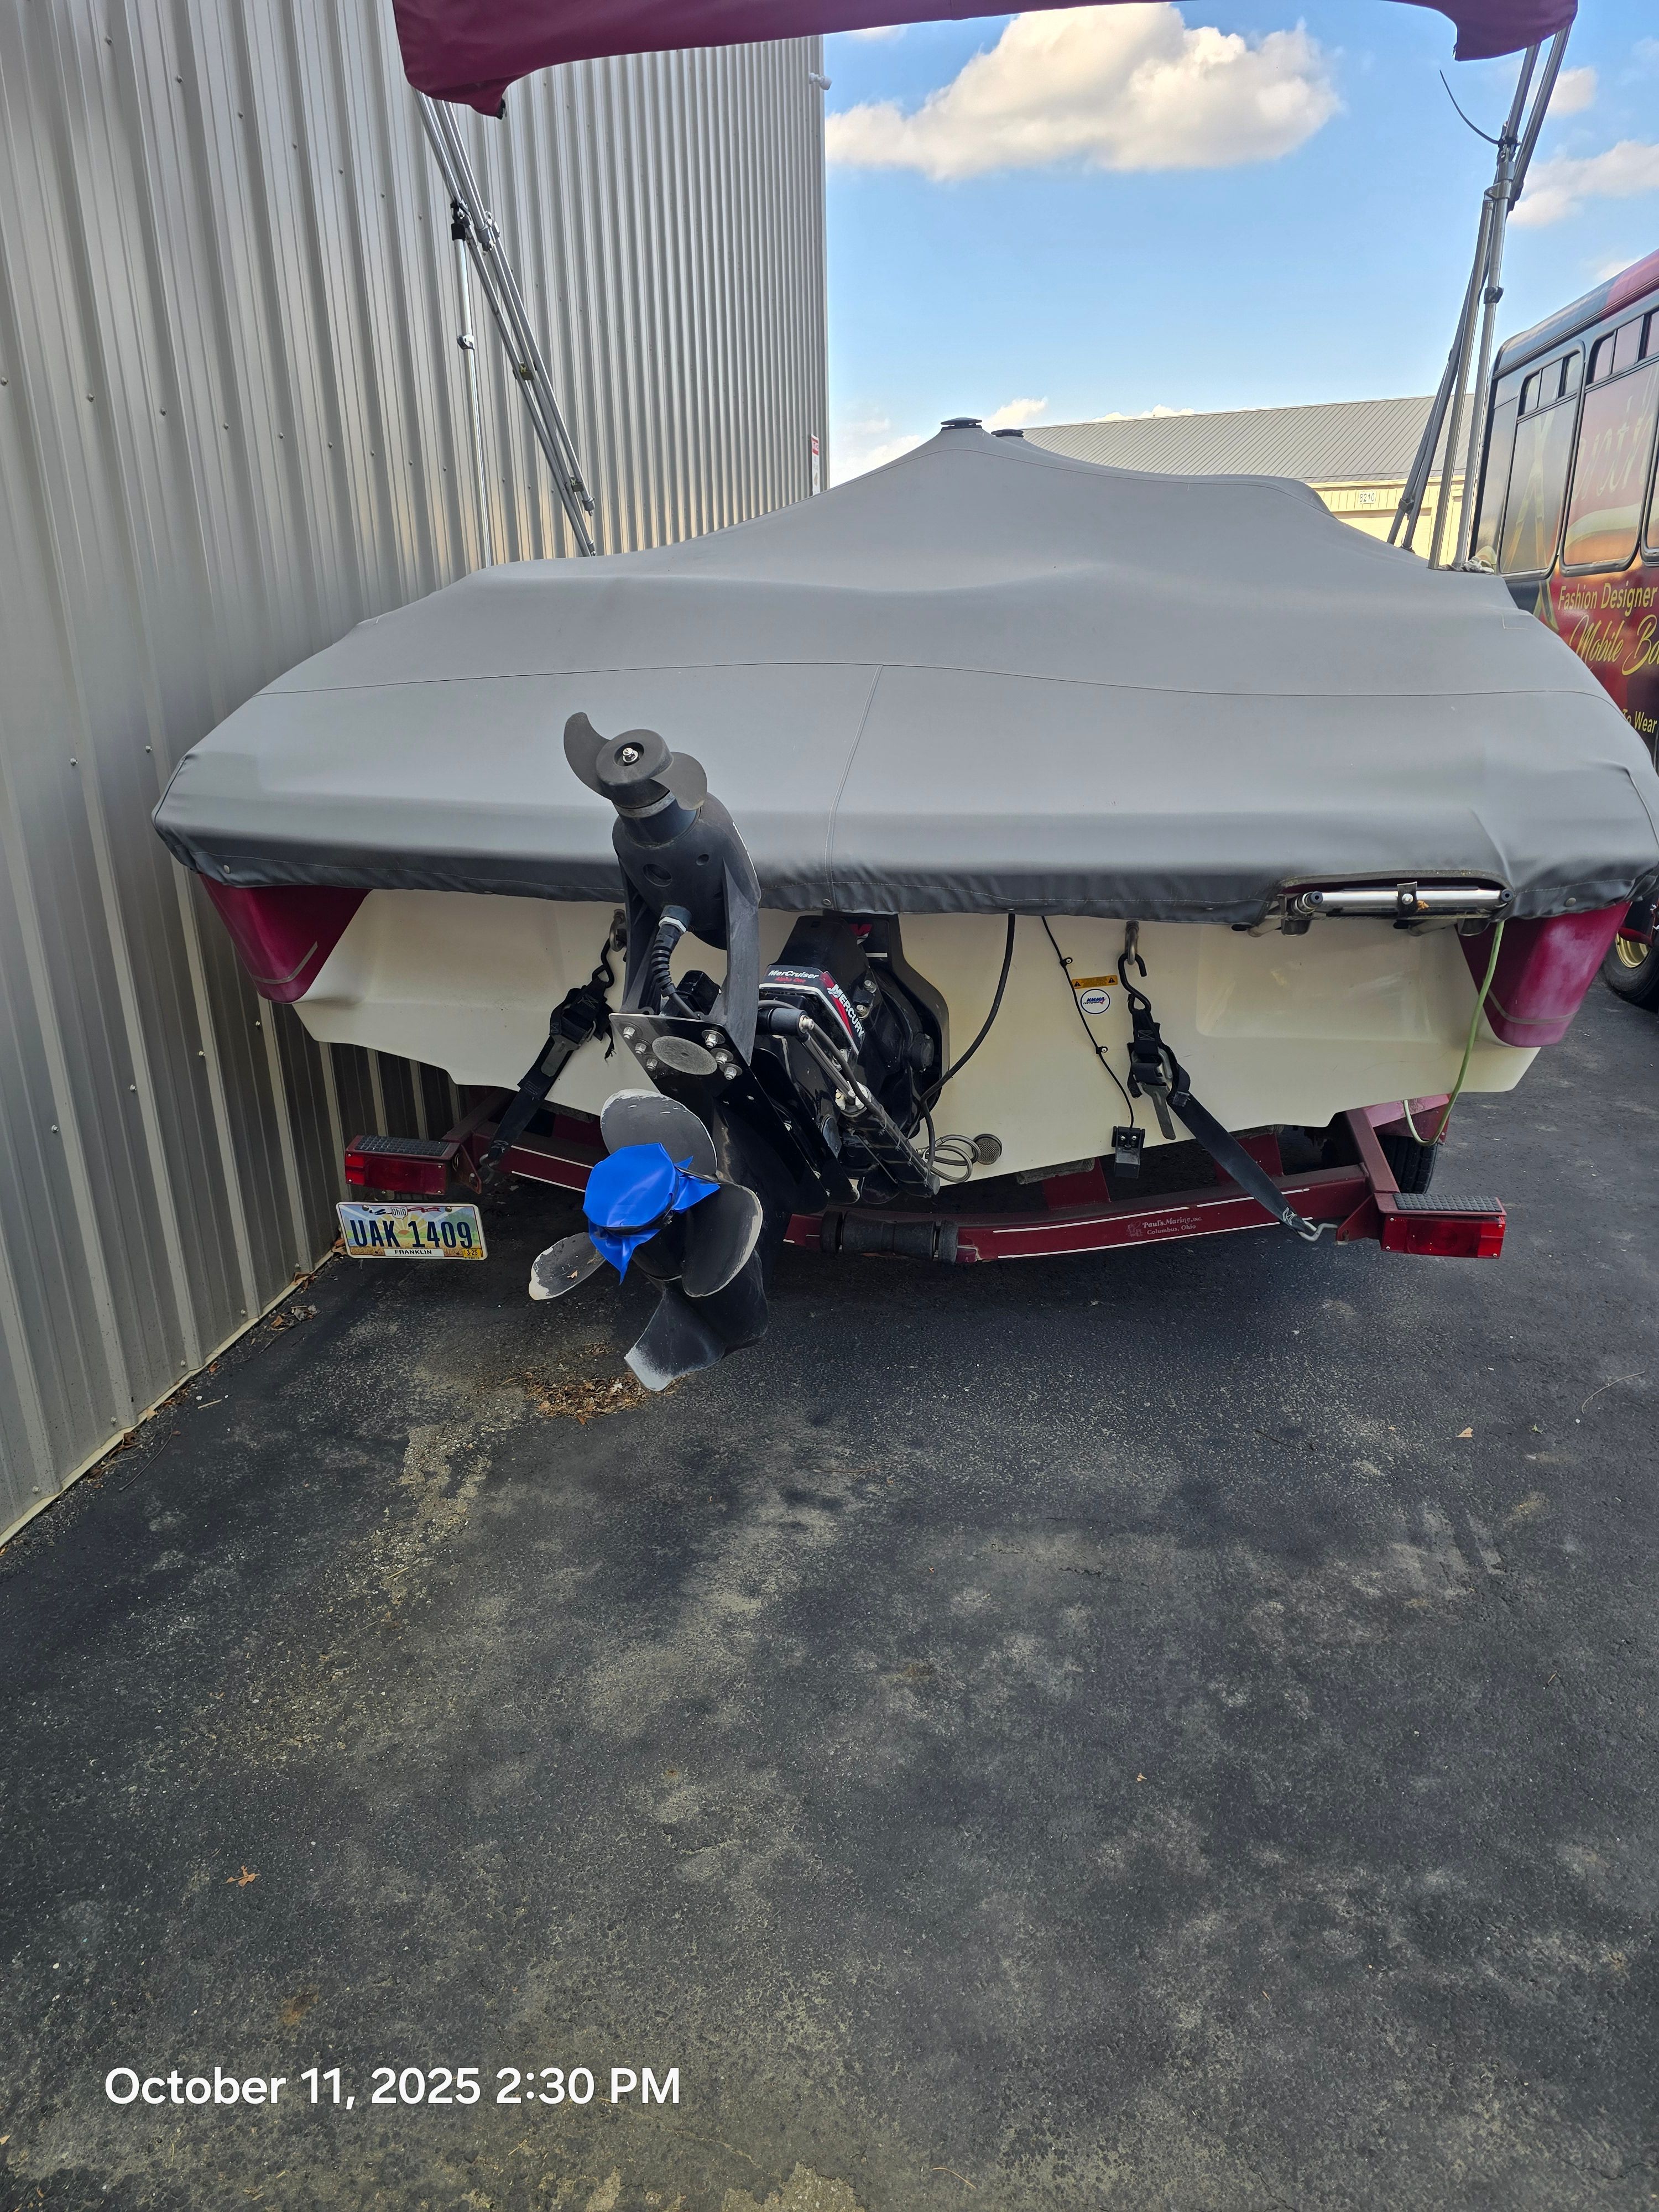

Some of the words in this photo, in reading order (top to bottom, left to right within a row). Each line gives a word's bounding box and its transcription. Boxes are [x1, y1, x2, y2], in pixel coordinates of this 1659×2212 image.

[1359, 493, 1375, 502] 8210
[1558, 583, 1598, 611] Fashion
[1601, 580, 1658, 617] Designer
[1569, 614, 1625, 664] Mobile
[1635, 711, 1657, 733] Wear
[768, 970, 820, 979] MerCruiser
[827, 983, 865, 1038] MERCURY
[350, 1220, 401, 1248] UAK
[408, 1220, 473, 1248] 1409
